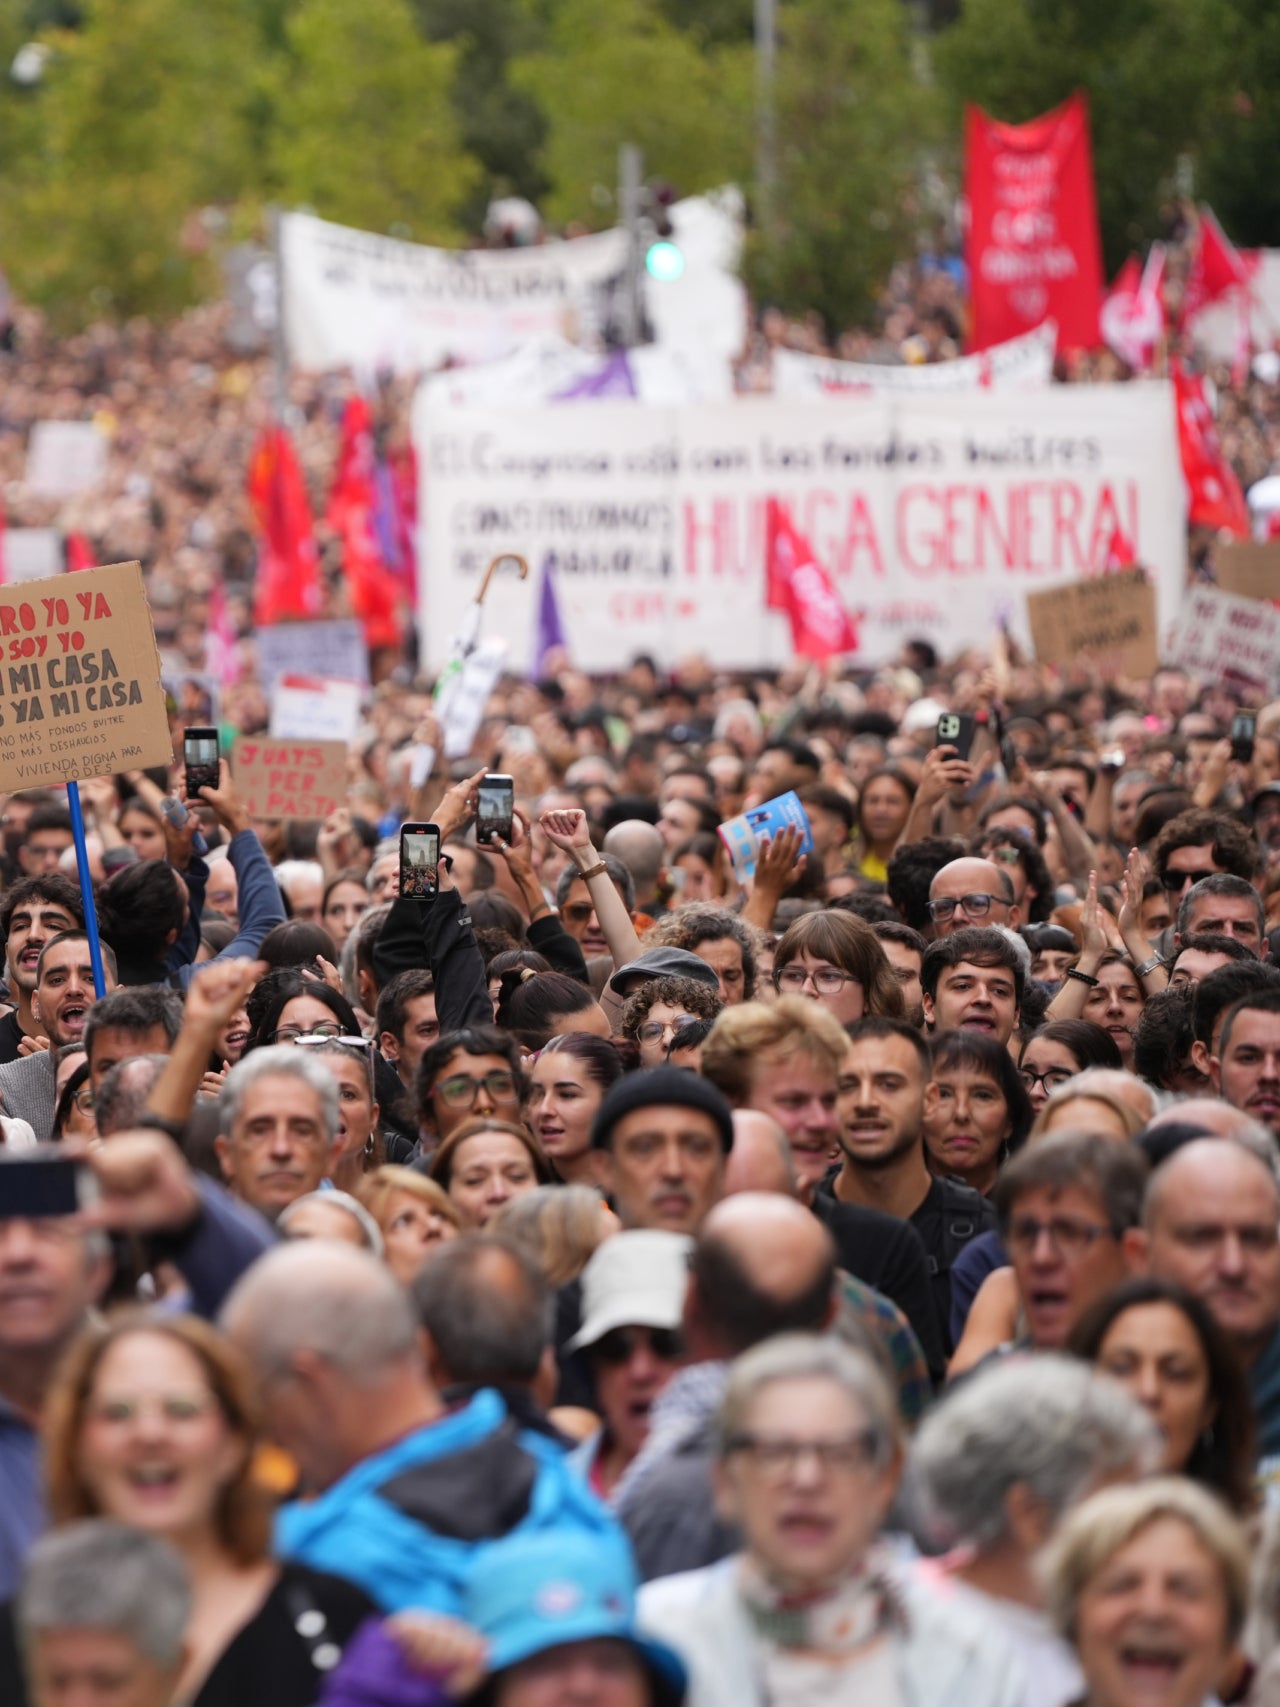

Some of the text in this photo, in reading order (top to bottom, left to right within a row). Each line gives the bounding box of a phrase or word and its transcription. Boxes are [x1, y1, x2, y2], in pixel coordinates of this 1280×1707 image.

[820, 433, 943, 470] fondos
[680, 490, 885, 581] HUGA
[41, 598, 69, 627] YO
[76, 592, 112, 621] YA
[9, 635, 47, 660] SOY
[57, 631, 85, 652] YO
[8, 663, 41, 694] MI
[47, 648, 118, 688] CASA
[11, 696, 44, 724] YA
[50, 690, 79, 717] MI
[86, 680, 142, 711] CASA
[0, 715, 125, 747] NO MÁS FONDOS BUITRE
[2, 734, 107, 761] NO MÁS DESHAUCIOS
[16, 746, 142, 778] VIVIENDA DIGNA PARA
[61, 763, 112, 779] TODES
[269, 770, 316, 792] PER
[265, 792, 337, 817] PASTA
